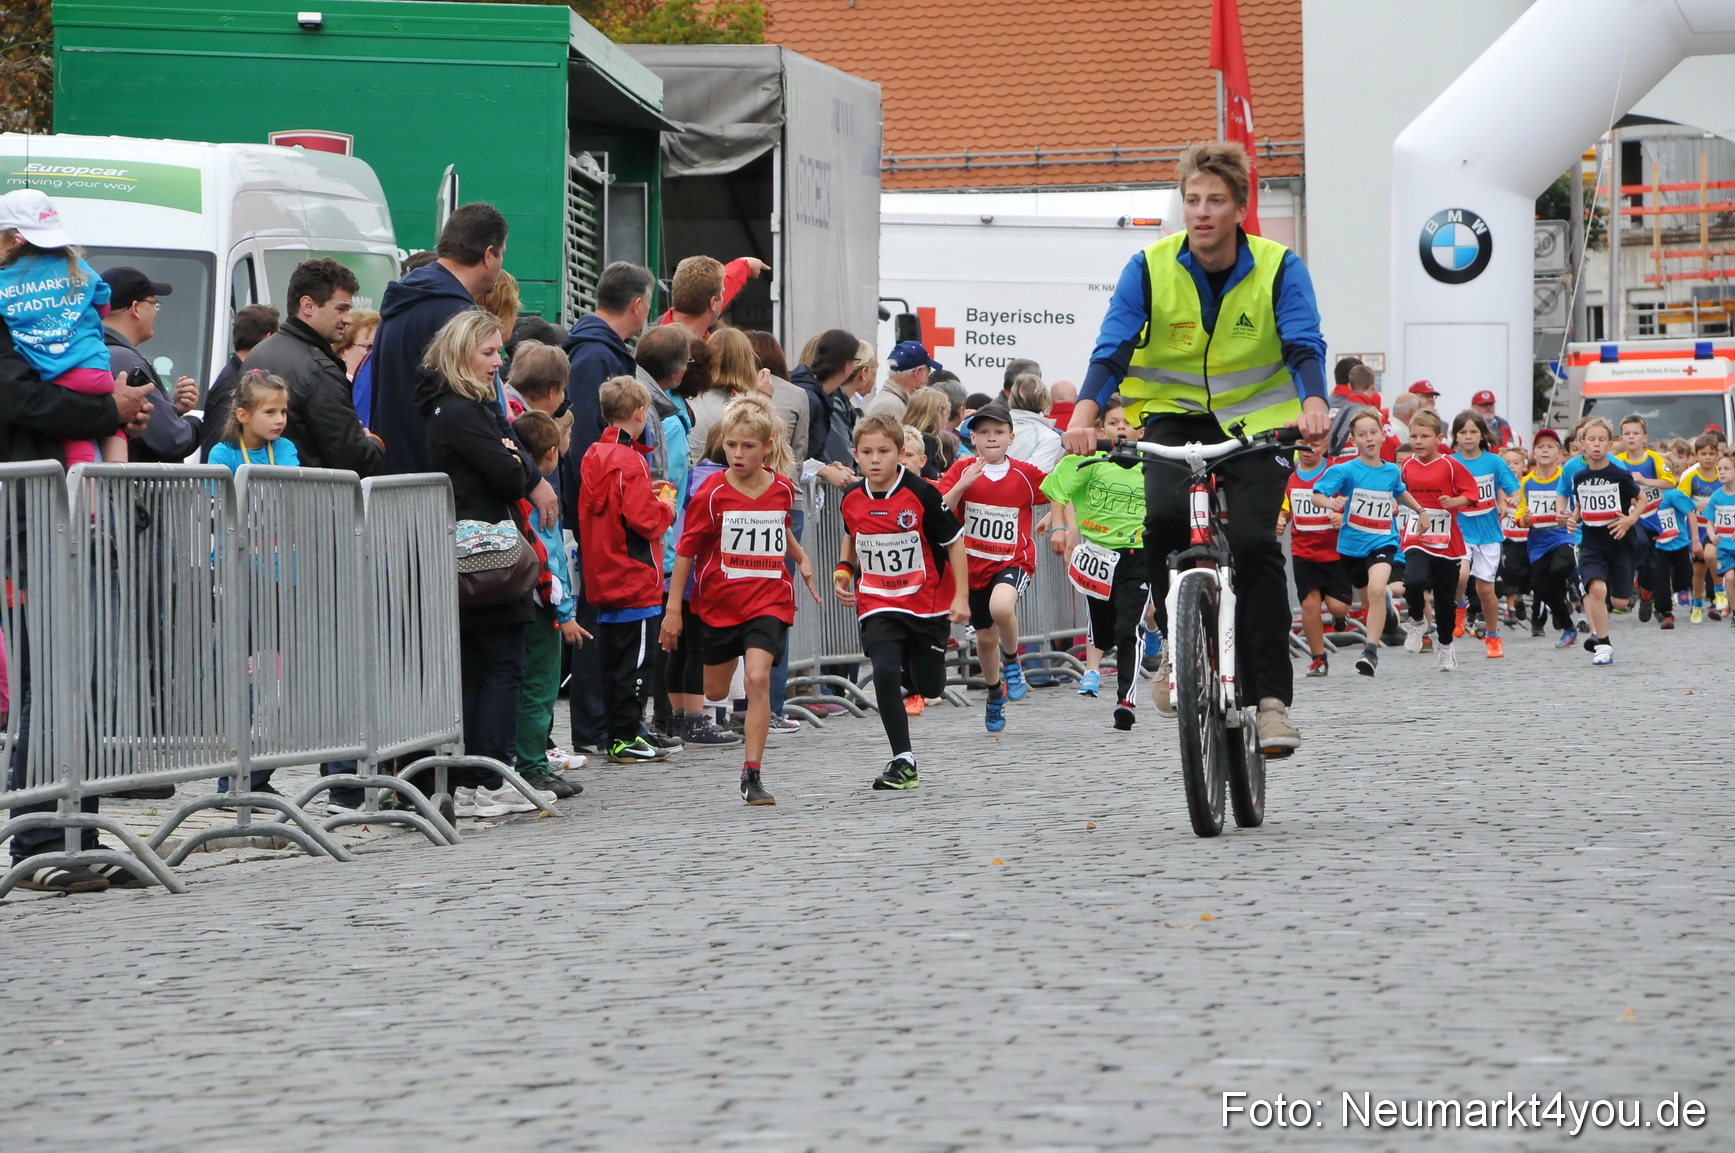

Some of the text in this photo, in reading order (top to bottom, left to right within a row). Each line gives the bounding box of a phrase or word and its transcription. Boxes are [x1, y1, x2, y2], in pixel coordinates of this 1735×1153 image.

[23, 163, 128, 176] Europcar
[7, 177, 136, 193] moving your way
[1425, 210, 1488, 236] BMW
[7, 293, 85, 316] STADTLAUF
[966, 307, 1075, 326] Bayerisches
[965, 330, 1016, 346] Rotes
[965, 352, 1016, 368] Kreu
[1356, 498, 1391, 518] 7112
[1533, 500, 1556, 514] 714
[1582, 494, 1616, 511] 7093
[725, 517, 749, 525] PARTL
[969, 515, 1014, 541] 7008
[1082, 518, 1109, 534] MERZ
[1412, 517, 1445, 533] 711
[730, 527, 784, 552] 7118
[875, 538, 908, 548] Neumarkt
[730, 556, 784, 569] Maximilian
[861, 547, 916, 572] 7137
[881, 578, 903, 588] Leon
